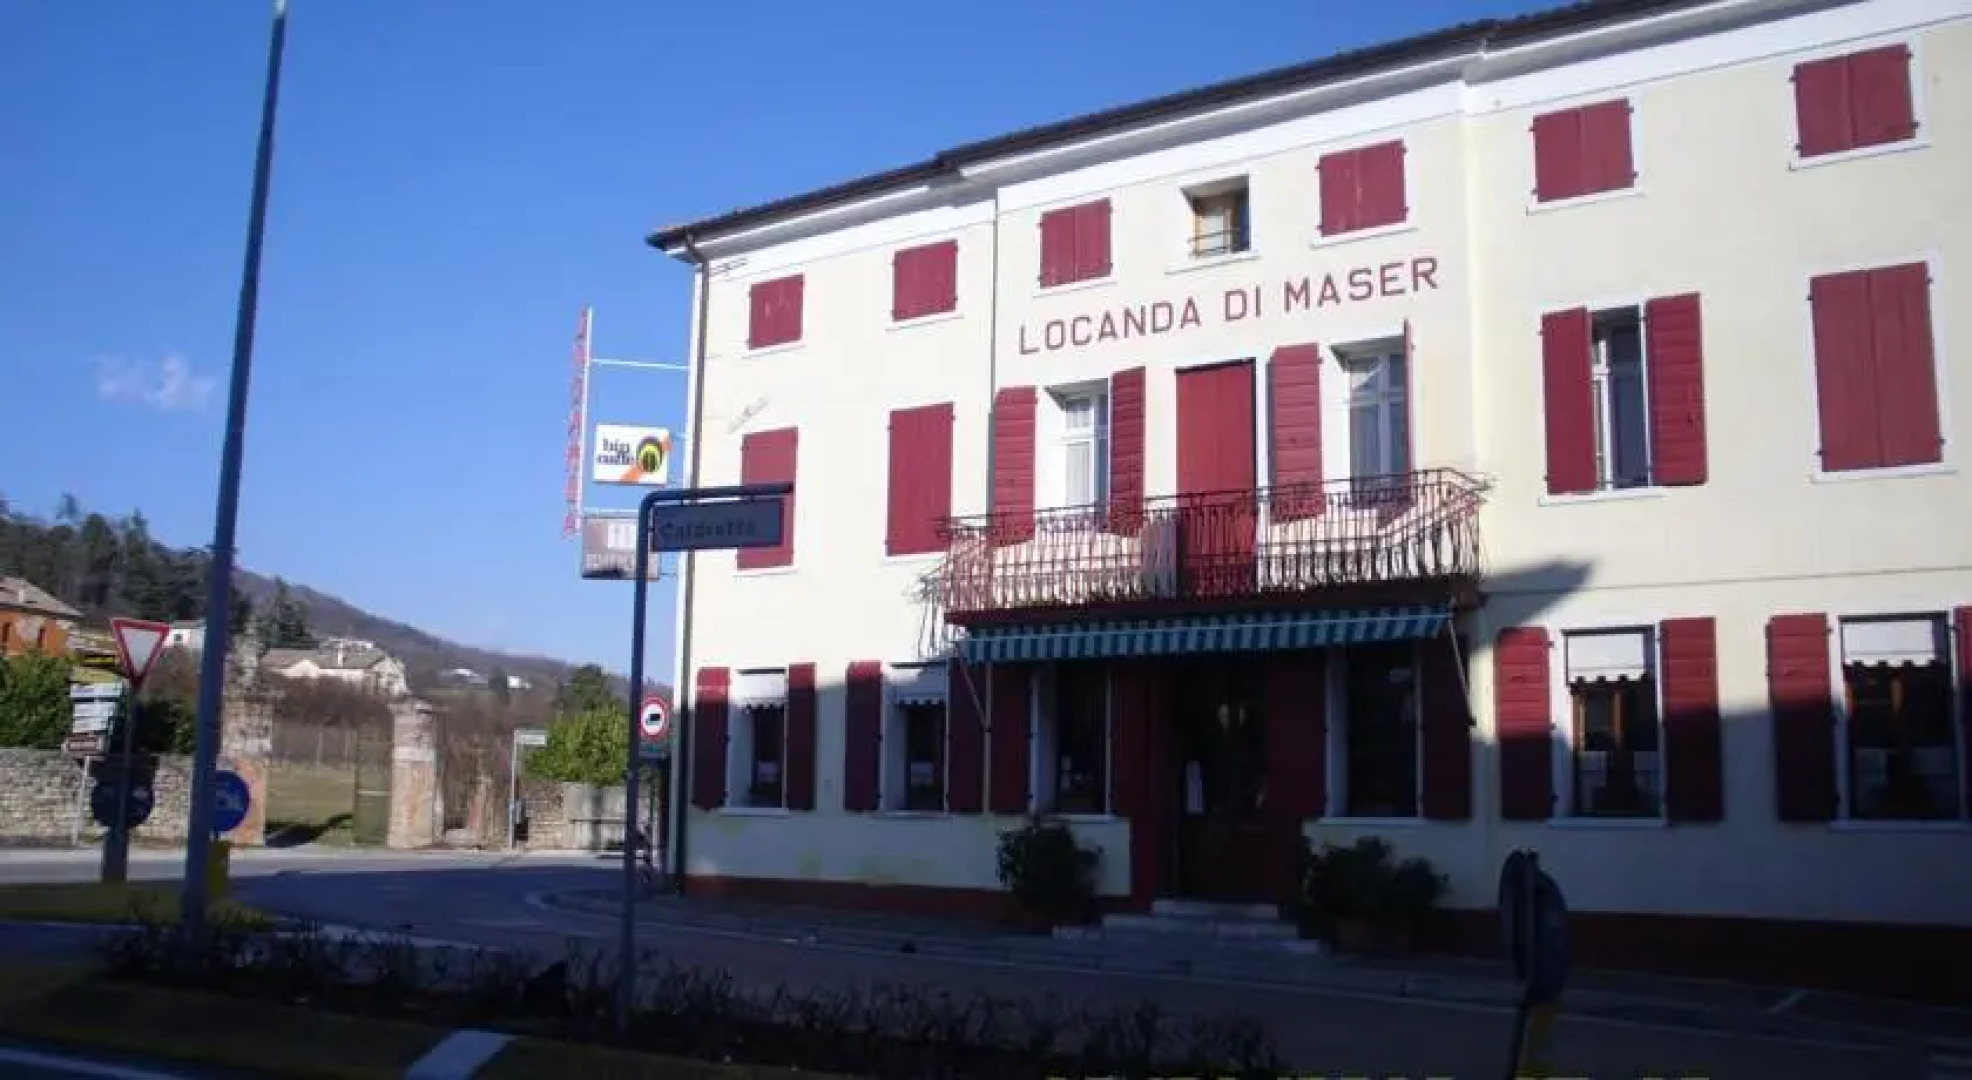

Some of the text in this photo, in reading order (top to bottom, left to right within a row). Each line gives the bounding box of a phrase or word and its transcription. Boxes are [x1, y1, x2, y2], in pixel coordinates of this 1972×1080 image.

[1019, 257, 1438, 355] LOCANDA DI MASER
